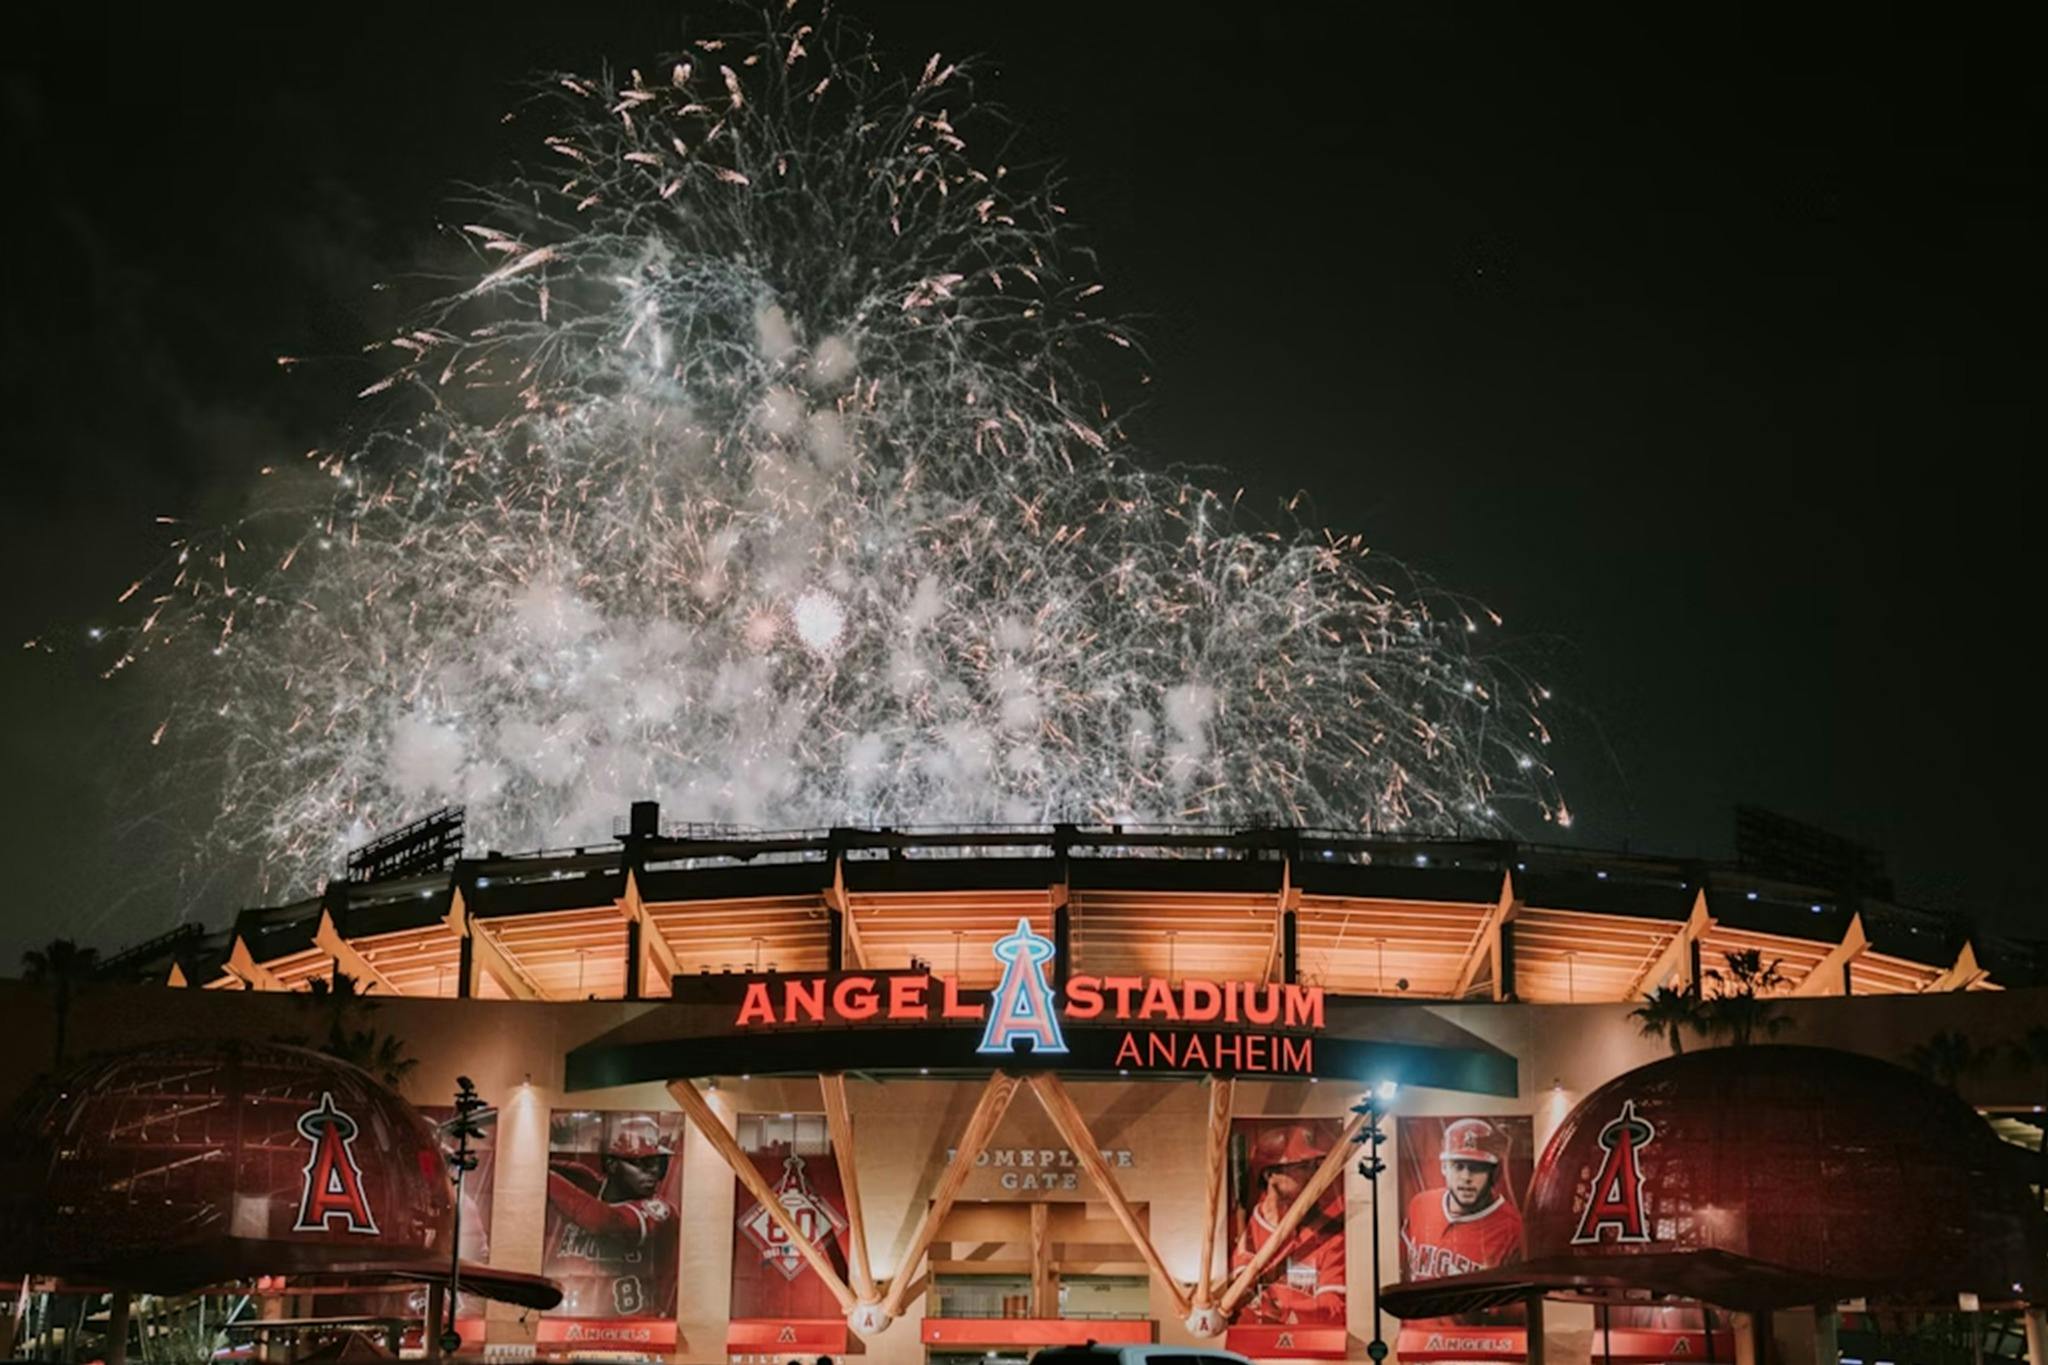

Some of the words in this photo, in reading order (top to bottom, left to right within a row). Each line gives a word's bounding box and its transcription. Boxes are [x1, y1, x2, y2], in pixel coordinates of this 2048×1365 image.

[976, 916, 1070, 1054] A
[1064, 976, 1326, 1029] STADIUM
[1115, 1031, 1313, 1074] ANAHEIM
[293, 1091, 380, 1235] A
[947, 1149, 1132, 1168] OMEPLTE
[1001, 1172, 1077, 1190] GATE
[1570, 1099, 1652, 1245] A
